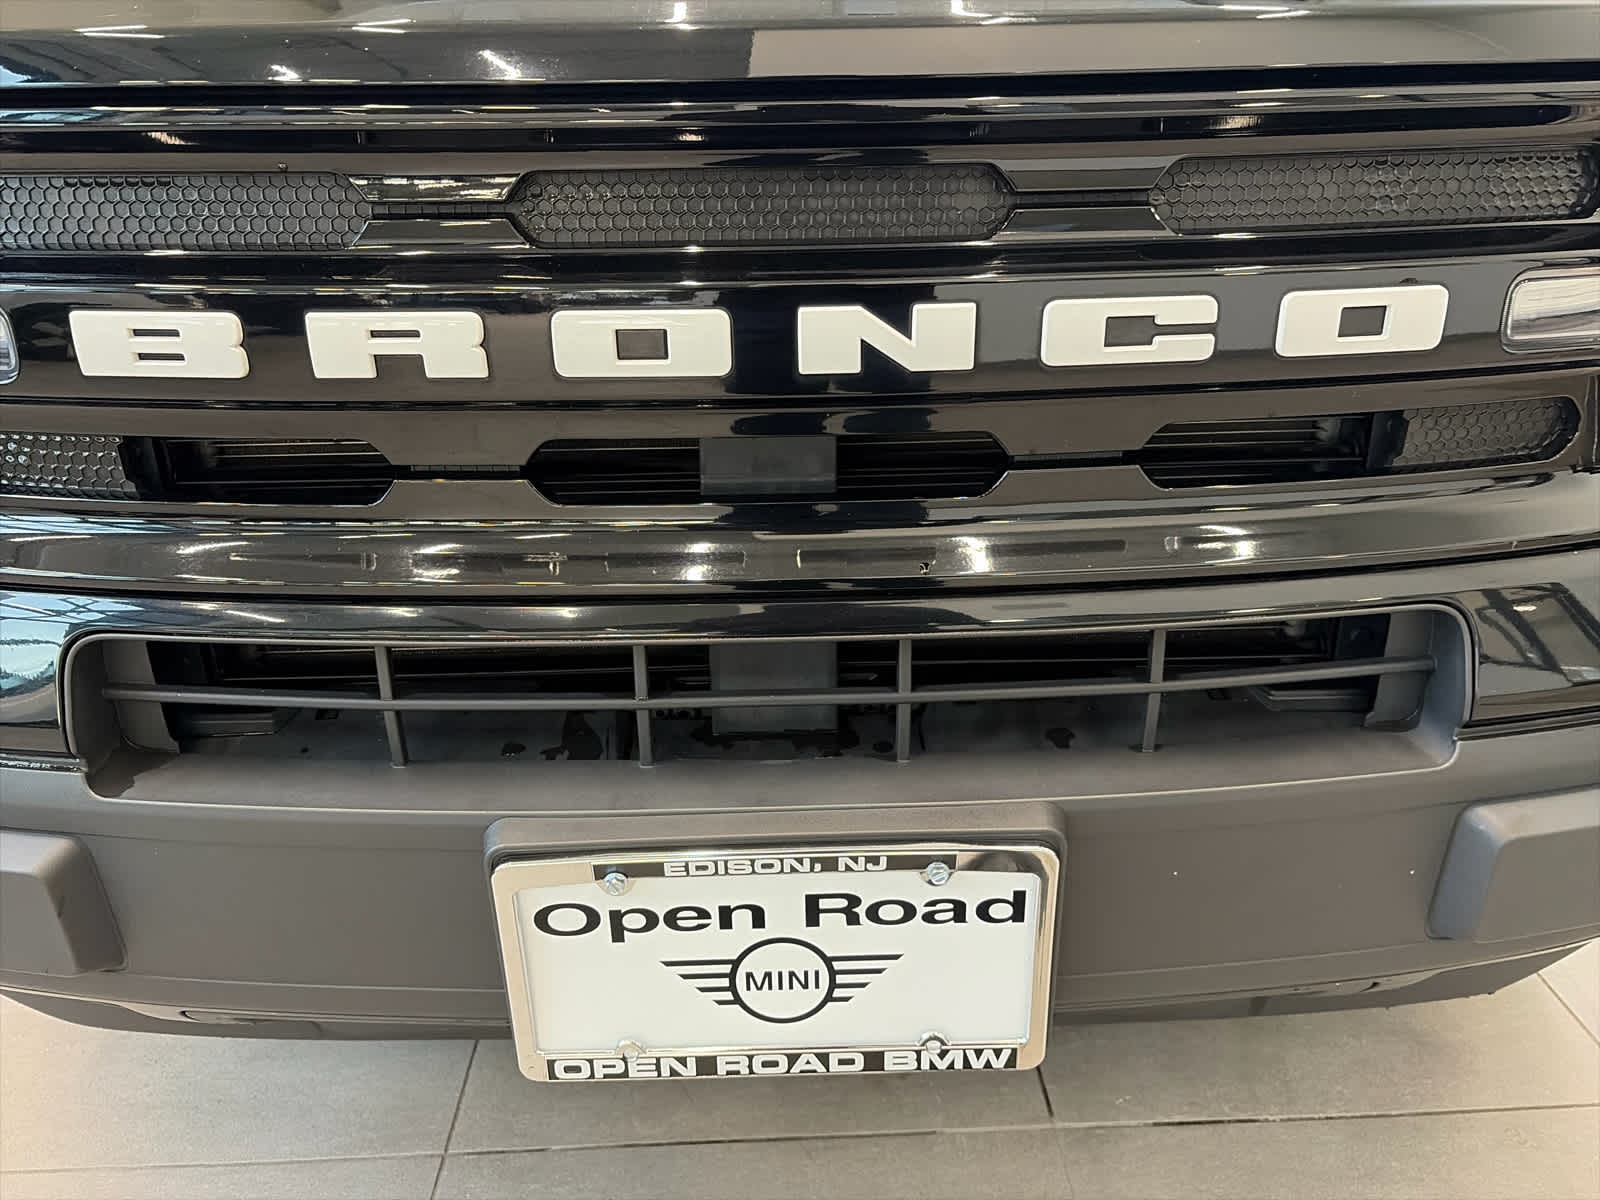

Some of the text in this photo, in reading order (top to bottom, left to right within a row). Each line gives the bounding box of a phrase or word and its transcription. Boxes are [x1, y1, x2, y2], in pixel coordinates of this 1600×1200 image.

[68, 284, 1449, 379] BRONCO
[664, 855, 888, 877] EDISON, NJ
[534, 889, 1027, 943] Open Road
[745, 970, 820, 991] MINI
[554, 1048, 1013, 1079] OPEN ROAD BMW
